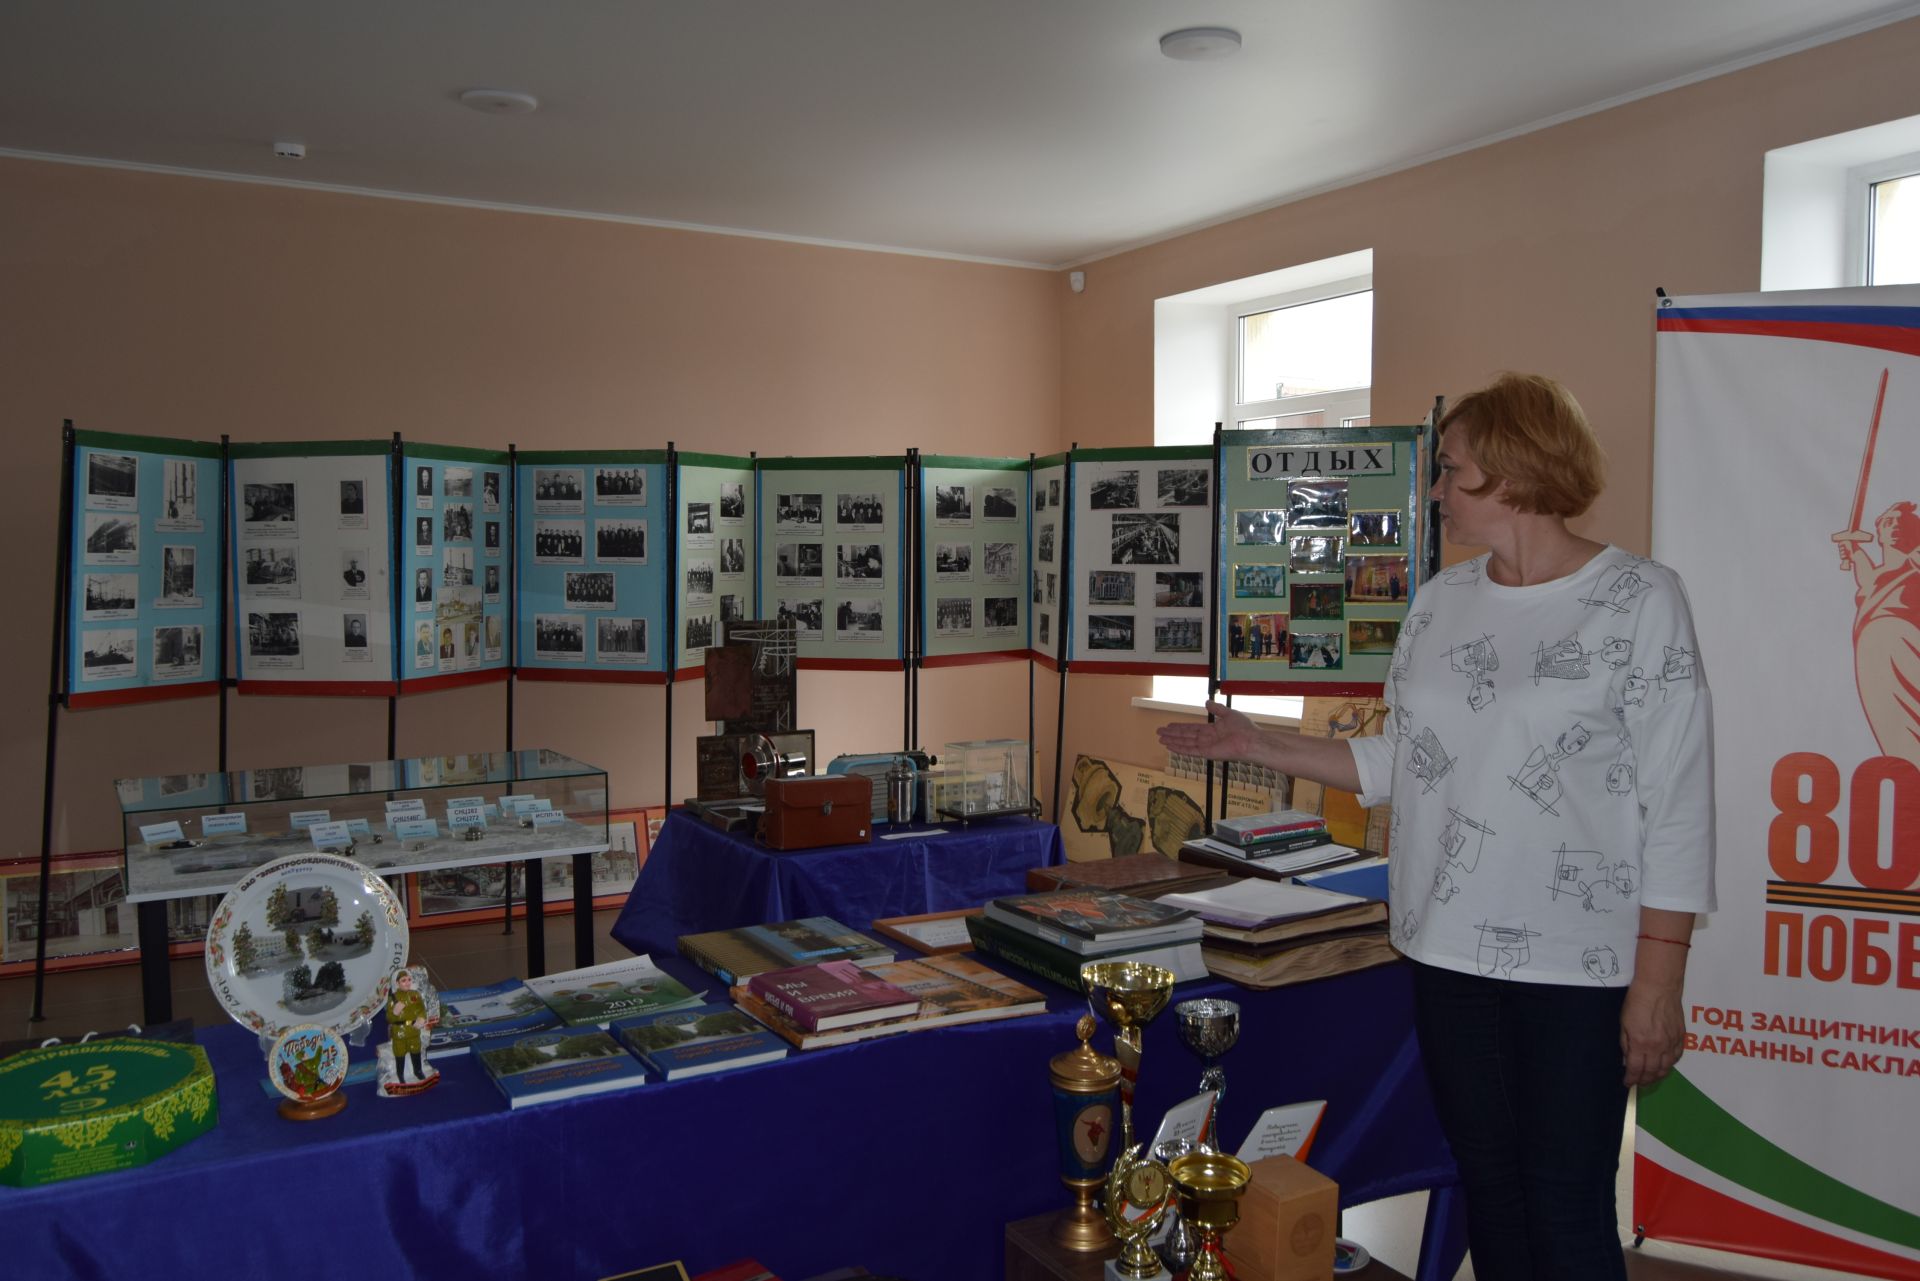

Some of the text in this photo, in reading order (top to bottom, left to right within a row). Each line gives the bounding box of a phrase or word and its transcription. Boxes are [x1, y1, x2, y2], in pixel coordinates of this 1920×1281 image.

[1251, 449, 1384, 477] ОТДЫХ
[1767, 752, 1920, 891] 80
[240, 875, 257, 892] ОАО
[256, 857, 361, 879] "ЭЛЕКТРОСОЕДИНИТЕЛЬ"
[390, 942, 404, 971] 2012
[217, 980, 241, 1008] 1967
[777, 981, 808, 991] МЫ
[787, 989, 802, 998] И
[798, 989, 858, 1004] ВРЕМЯ
[605, 998, 644, 1010] 2019
[1691, 1005, 1744, 1032] ГОД
[322, 1044, 338, 1060] 75
[1683, 1033, 1813, 1065] ВАТАННЫ
[40, 1064, 117, 1088] 45
